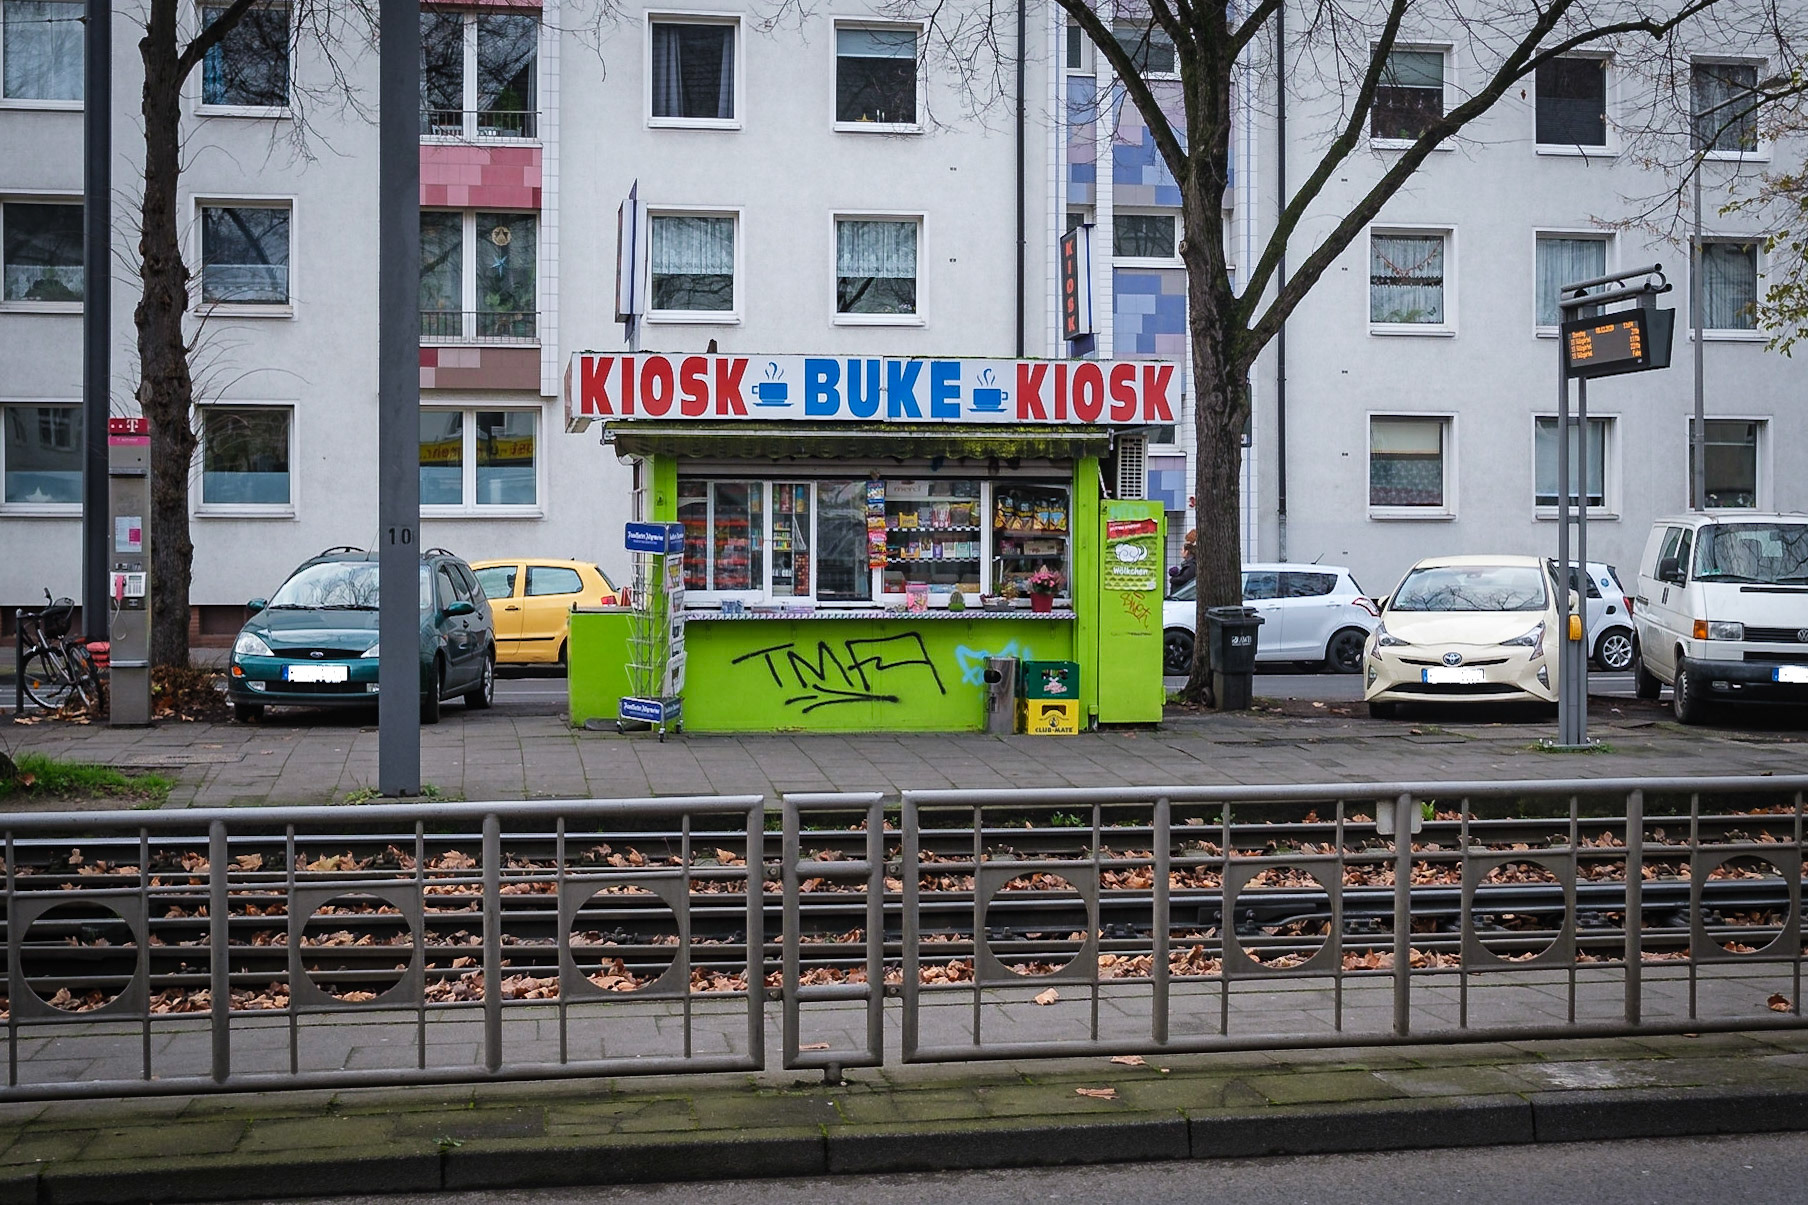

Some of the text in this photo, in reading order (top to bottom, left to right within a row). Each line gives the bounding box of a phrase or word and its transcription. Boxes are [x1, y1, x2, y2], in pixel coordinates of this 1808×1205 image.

[1065, 239, 1076, 332] KIOSK
[580, 356, 749, 417] KIOSK
[804, 358, 961, 419] BUKE
[1016, 362, 1175, 422] KIOSK
[126, 419, 139, 433] T
[388, 527, 412, 545] 10
[1112, 566, 1149, 576] Wölkchen
